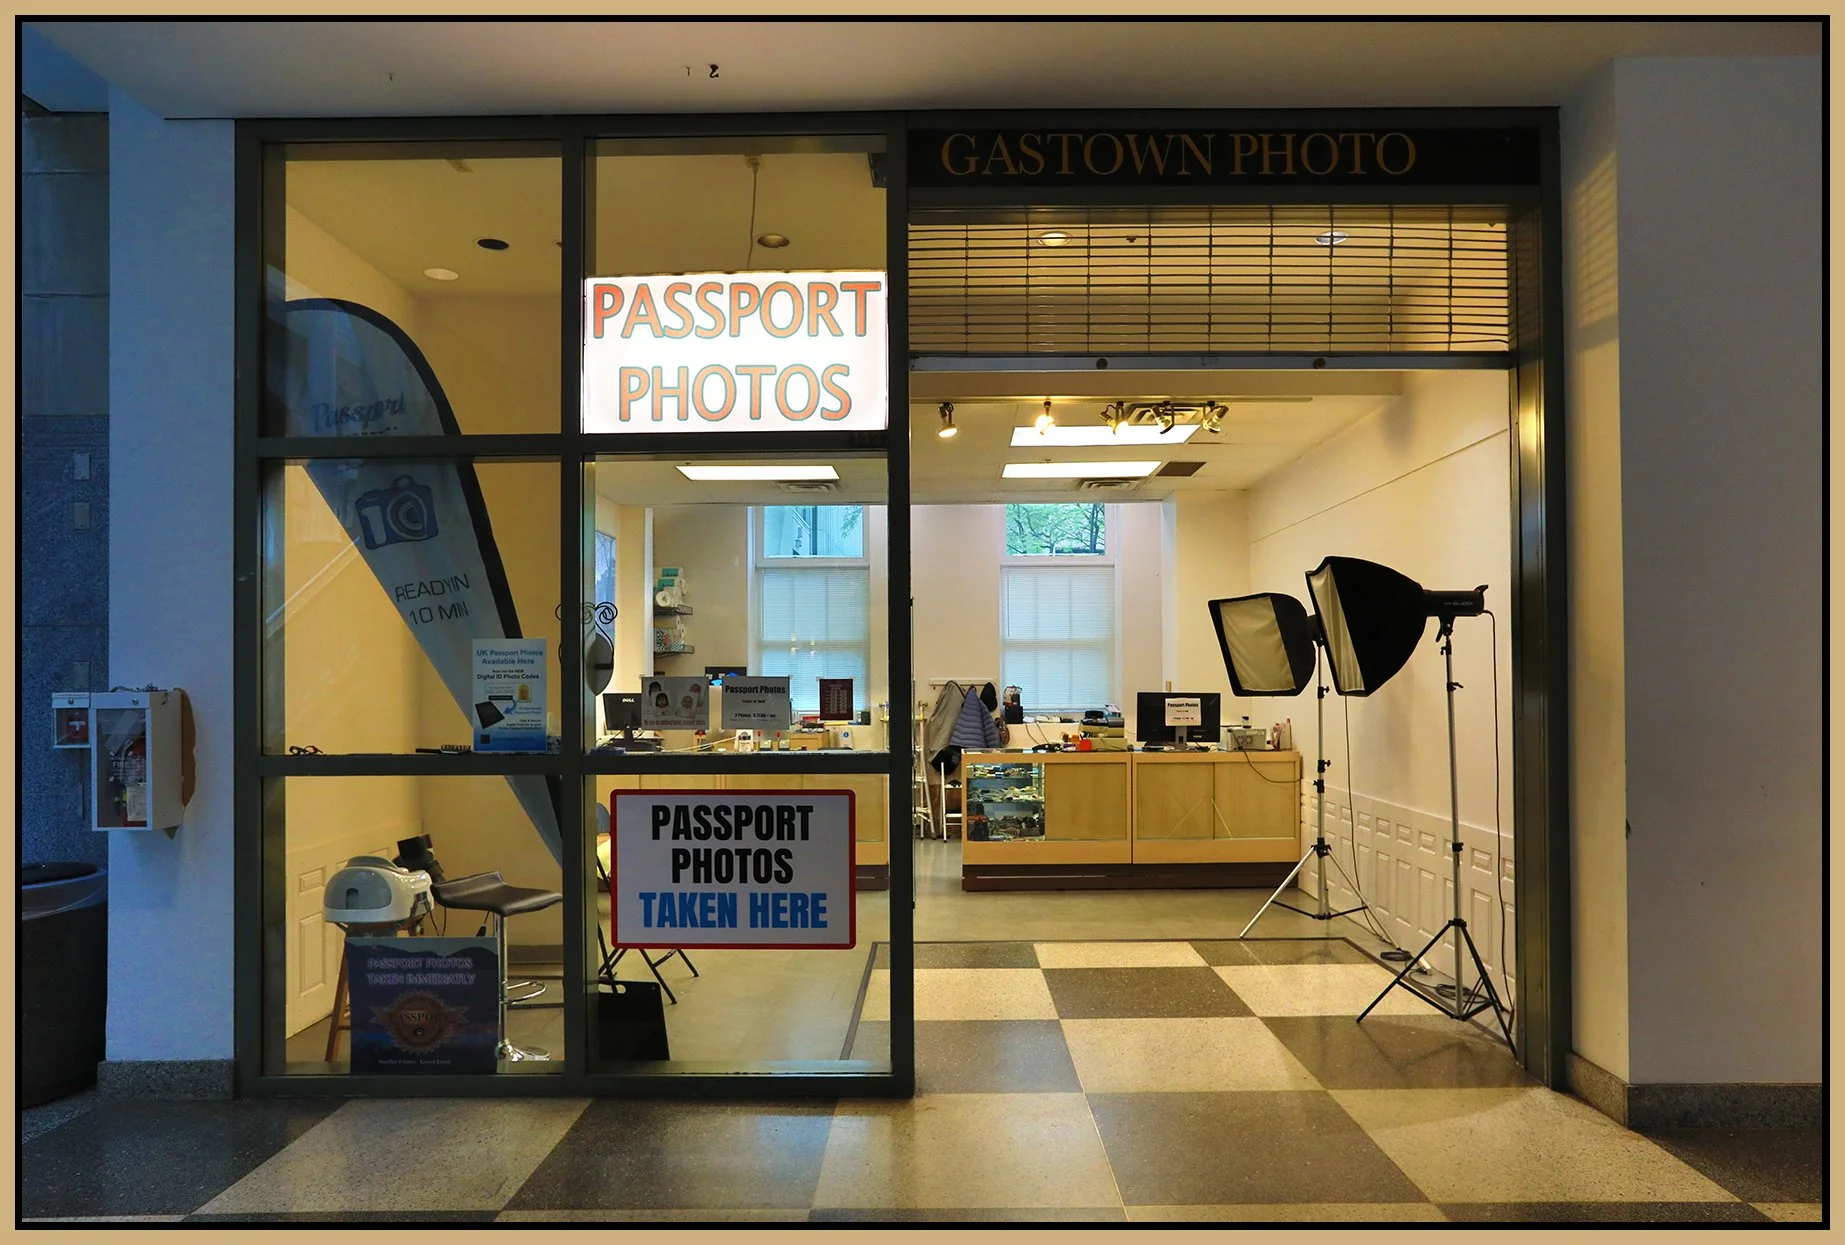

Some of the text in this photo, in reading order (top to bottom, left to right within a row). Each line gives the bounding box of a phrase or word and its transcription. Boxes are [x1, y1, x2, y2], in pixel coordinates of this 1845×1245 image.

[942, 132, 1417, 176] GASTOWN PHOTO
[592, 281, 882, 339] PASSPORT
[618, 363, 853, 422] PHOTOS
[410, 606, 434, 625] 10
[725, 685, 786, 695] Passport Photos
[651, 804, 814, 841] PASSPORT
[671, 848, 794, 884] PHOTOS
[638, 892, 828, 928] TAKEN HERE
[367, 957, 474, 969] PASSPORT PHOTOS
